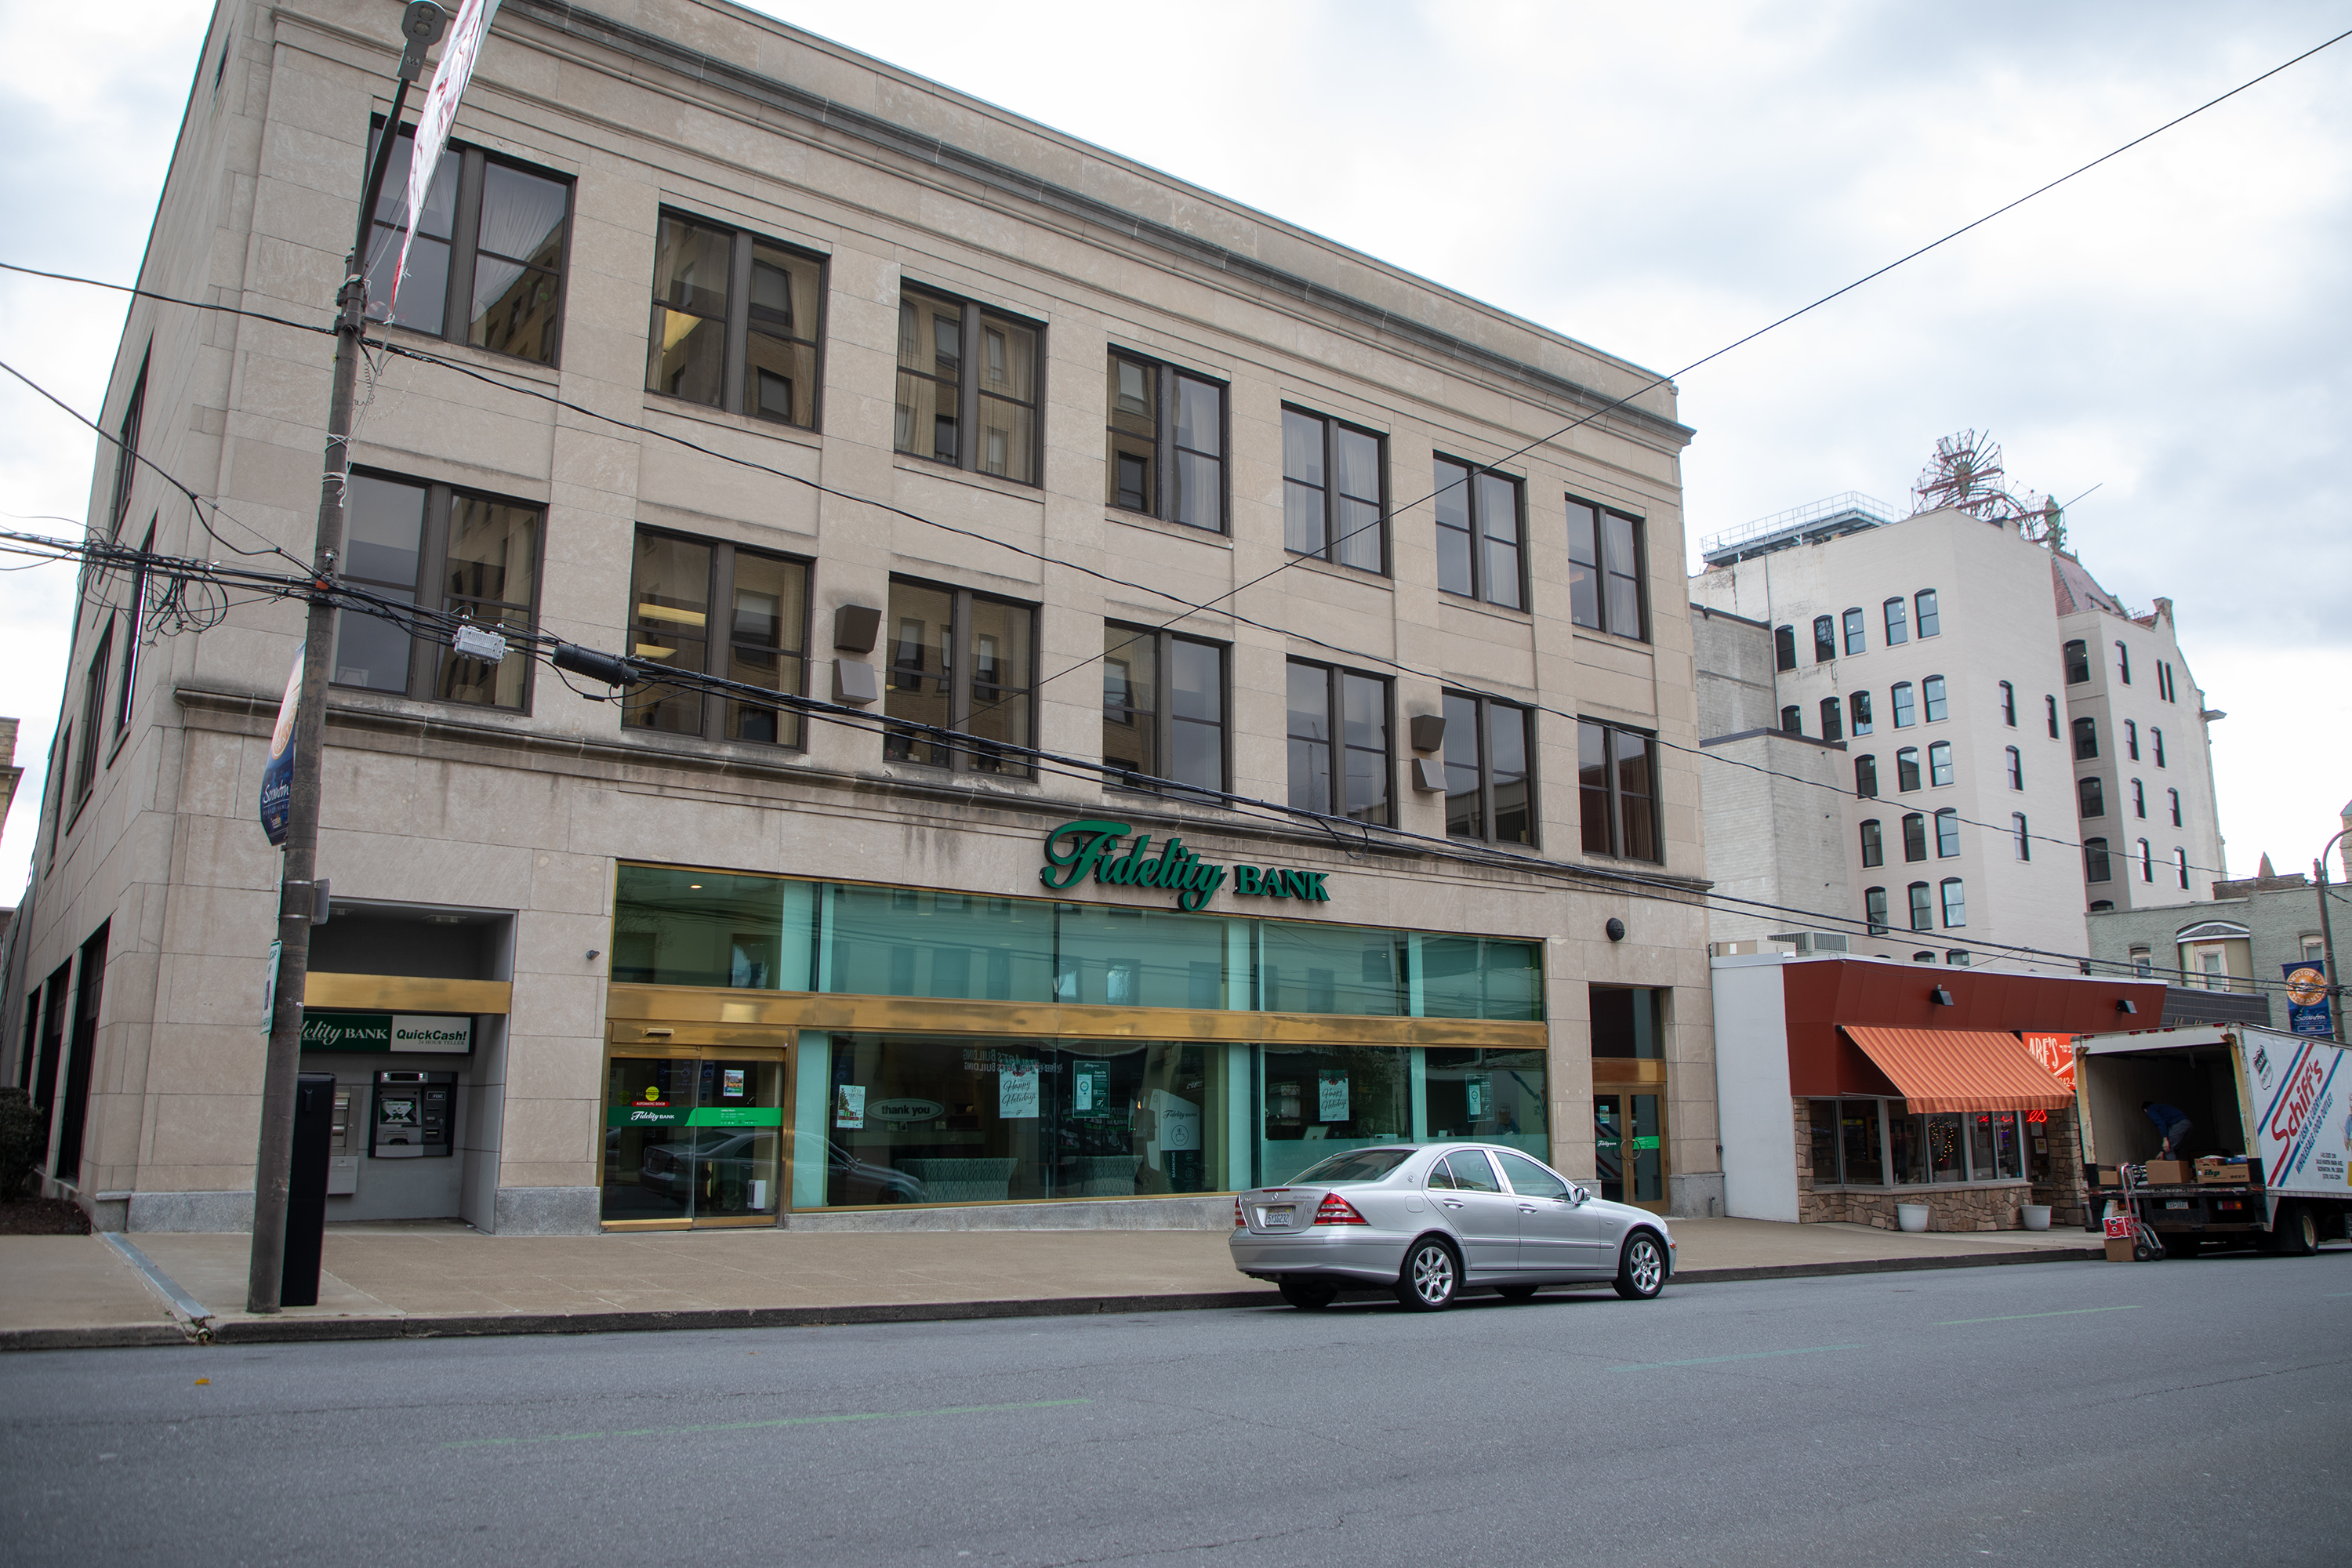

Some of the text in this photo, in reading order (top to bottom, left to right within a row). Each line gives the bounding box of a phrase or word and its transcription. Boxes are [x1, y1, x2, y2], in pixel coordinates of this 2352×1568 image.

[1040, 820, 1331, 912] Fidelity BANK
[2295, 1013, 2326, 1022] Scranton
[345, 1028, 388, 1040] BANK
[396, 1029, 467, 1041] QuickCash!
[1003, 1080, 1031, 1092] Happy
[1321, 1087, 1343, 1099] Happy
[1002, 1093, 1036, 1107] Holidays
[1321, 1099, 1347, 1112] Holidays
[881, 1105, 930, 1116] thank you
[2270, 1054, 2323, 1159] Schiff's
[631, 1111, 659, 1122] Fidelity
[1163, 1110, 1185, 1120] Fidelity
[2298, 1121, 2310, 1146] CASH
[2309, 1094, 2321, 1120] CARRY
[2295, 1091, 2334, 1174] WHOLESALE FOOD OUTLET
[2204, 1169, 2220, 1178] ibp
